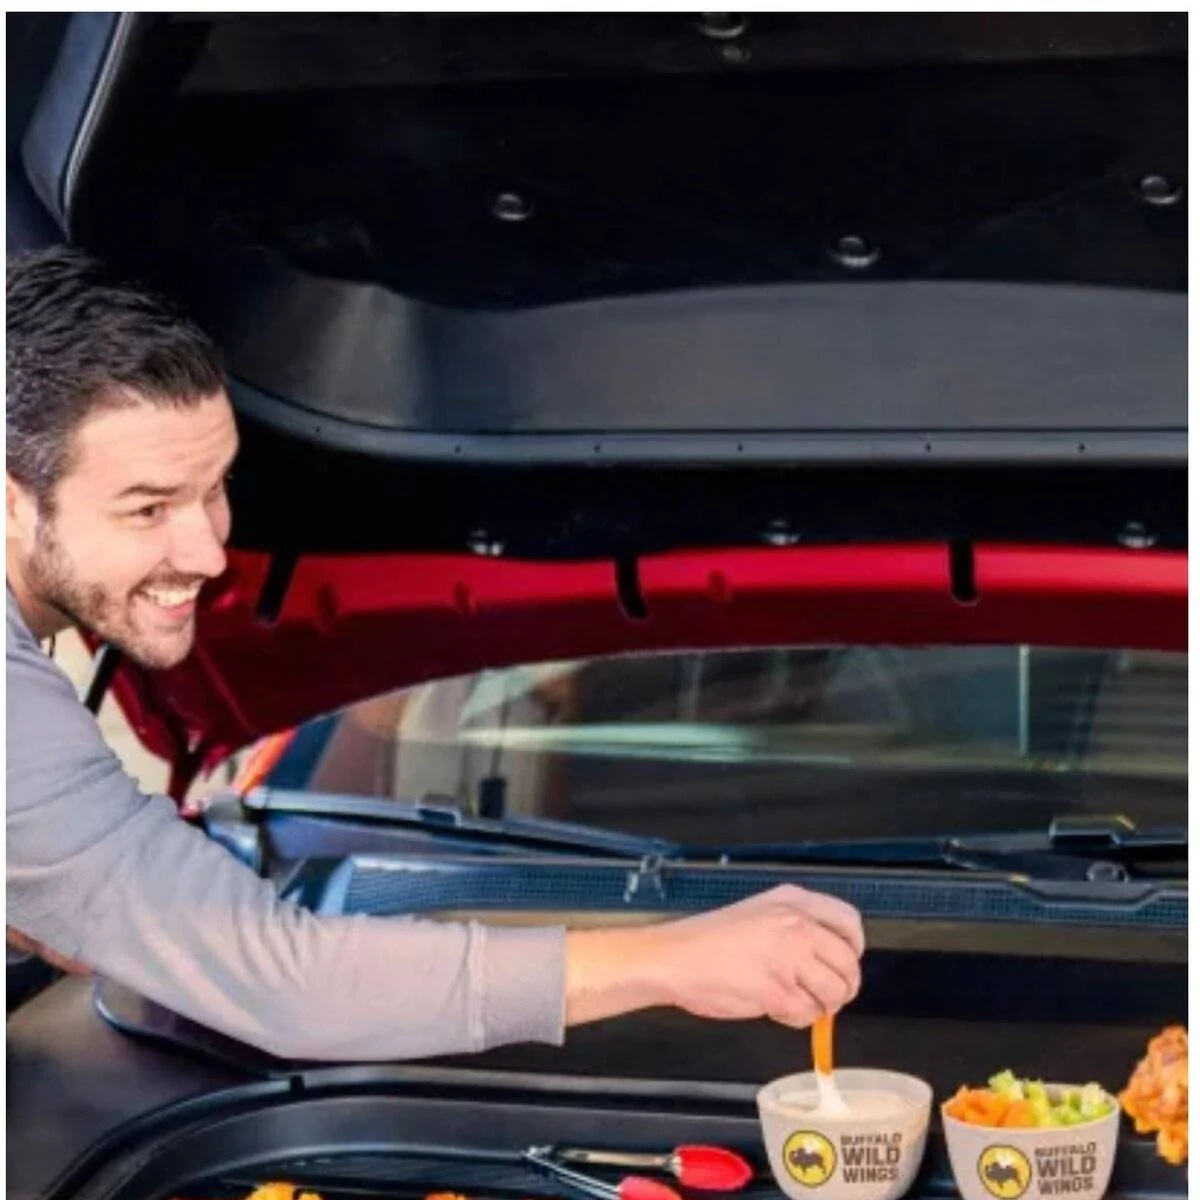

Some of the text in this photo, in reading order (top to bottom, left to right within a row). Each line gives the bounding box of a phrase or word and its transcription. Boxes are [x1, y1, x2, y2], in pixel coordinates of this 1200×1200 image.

[840, 1134, 902, 1146] BUFFALO
[841, 1147, 900, 1165] WILD
[843, 1167, 898, 1183] WINGS
[1035, 1156, 1097, 1177] WILD
[1038, 1177, 1094, 1195] WINGS
